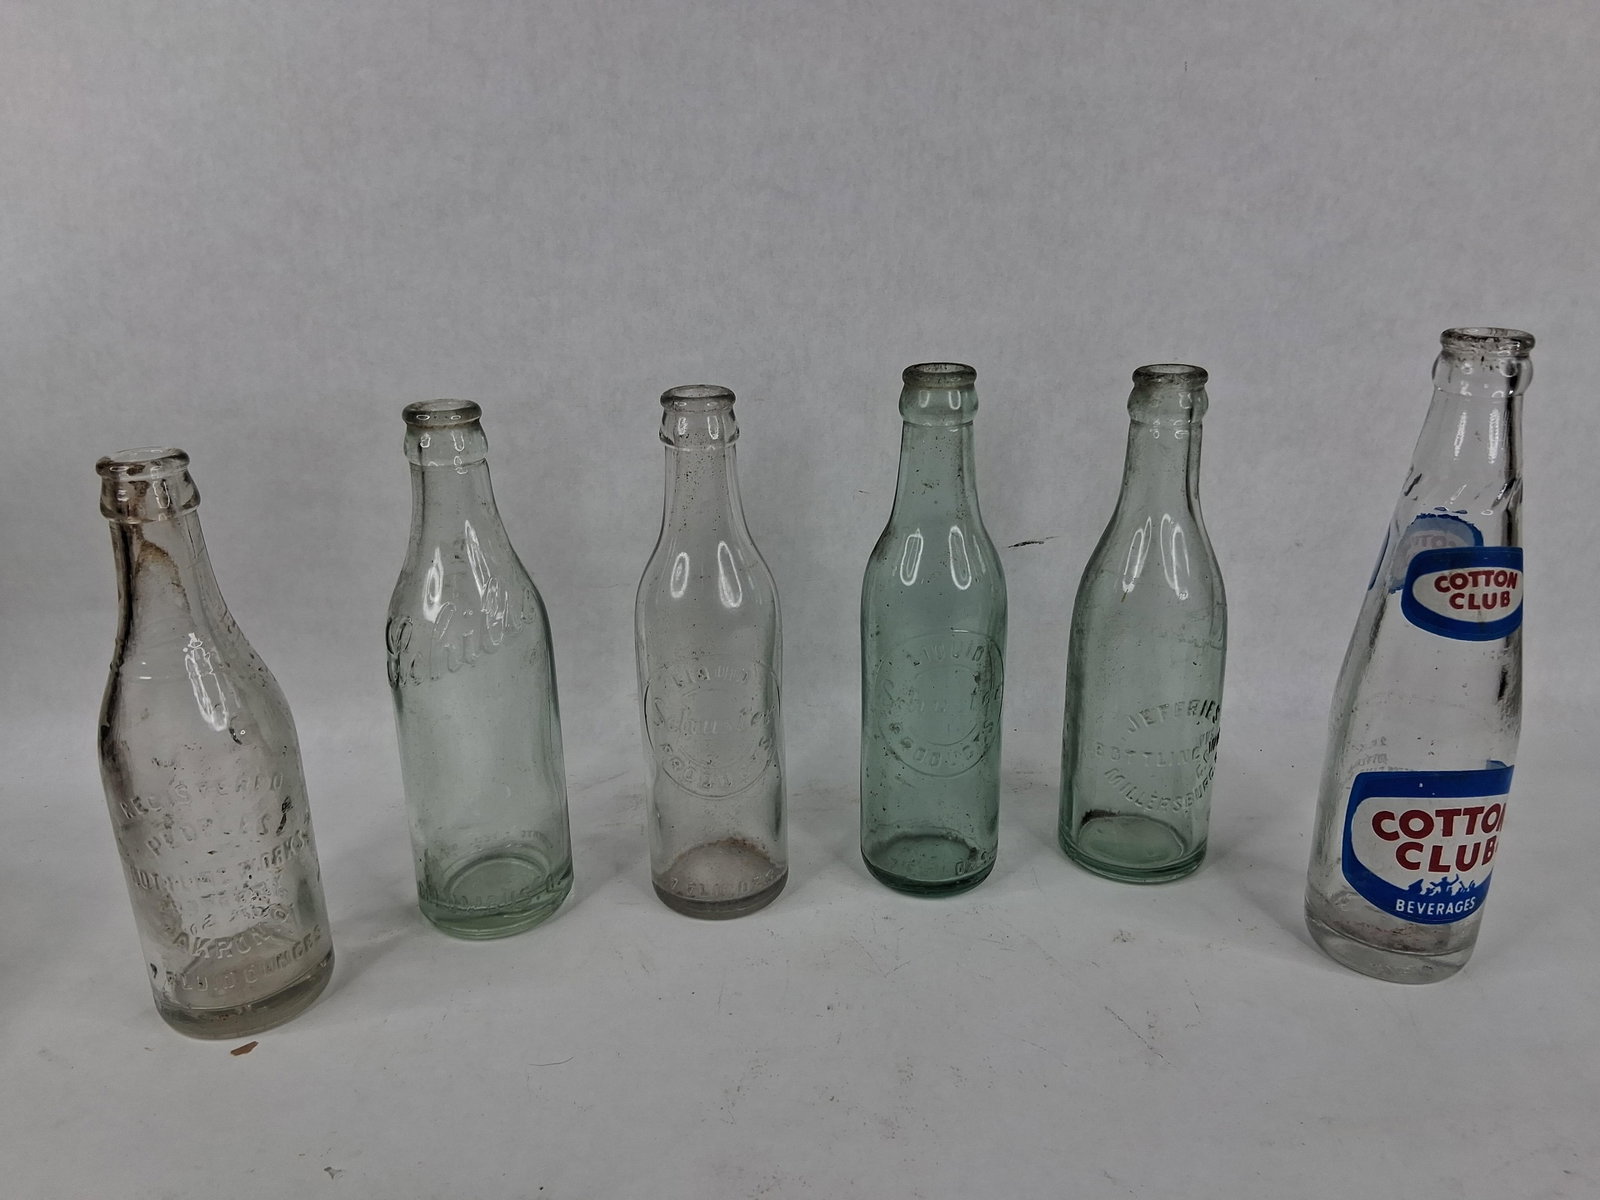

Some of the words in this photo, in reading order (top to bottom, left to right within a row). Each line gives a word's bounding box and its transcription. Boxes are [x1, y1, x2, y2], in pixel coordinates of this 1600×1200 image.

[1434, 570, 1518, 593] COTTON
[1449, 591, 1511, 610] CLUB
[1395, 834, 1498, 873] CLUB
[1395, 897, 1476, 916] BEVERAGES
